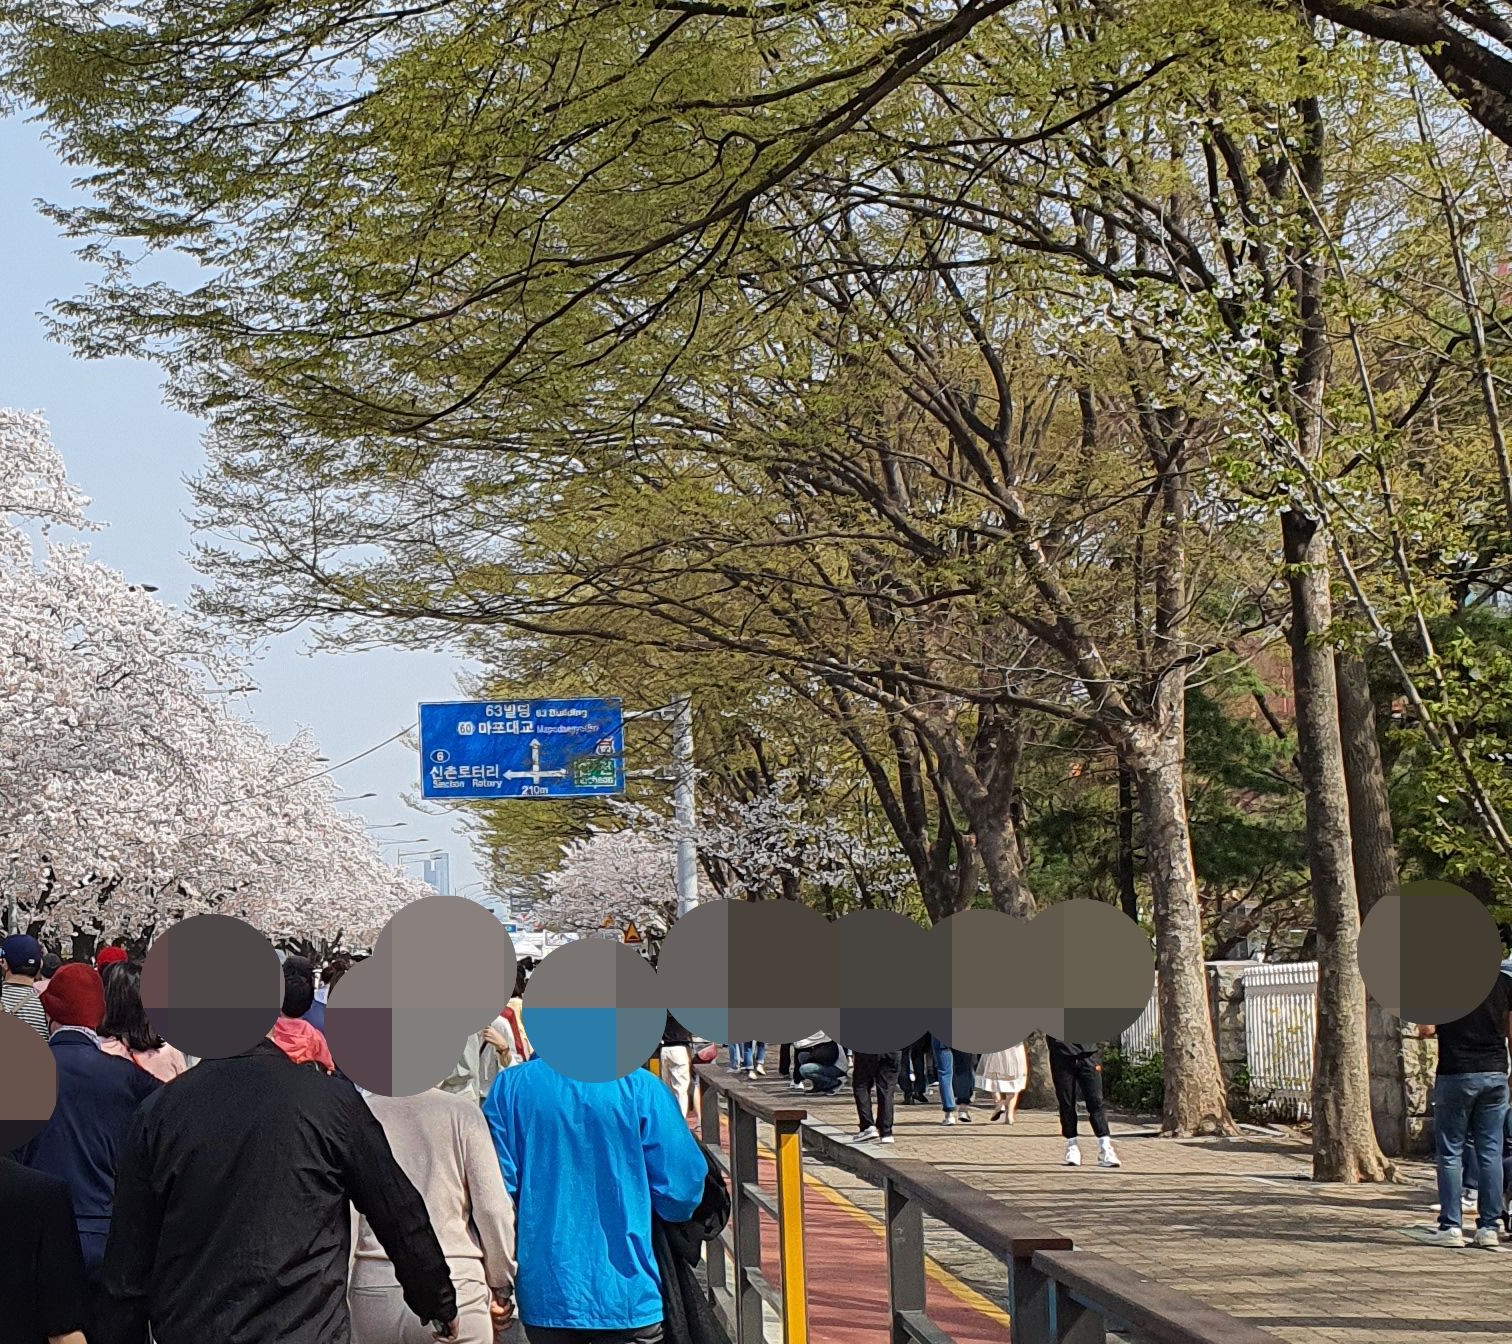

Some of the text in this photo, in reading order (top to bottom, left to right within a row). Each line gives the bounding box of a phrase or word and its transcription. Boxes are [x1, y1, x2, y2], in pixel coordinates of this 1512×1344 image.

[485, 703, 530, 719] 63빌딩
[478, 720, 534, 735] 마포대교
[436, 751, 444, 761] 6
[430, 764, 499, 780] 신촌로터리
[472, 778, 503, 789] Rotary
[521, 785, 549, 796] 210m
